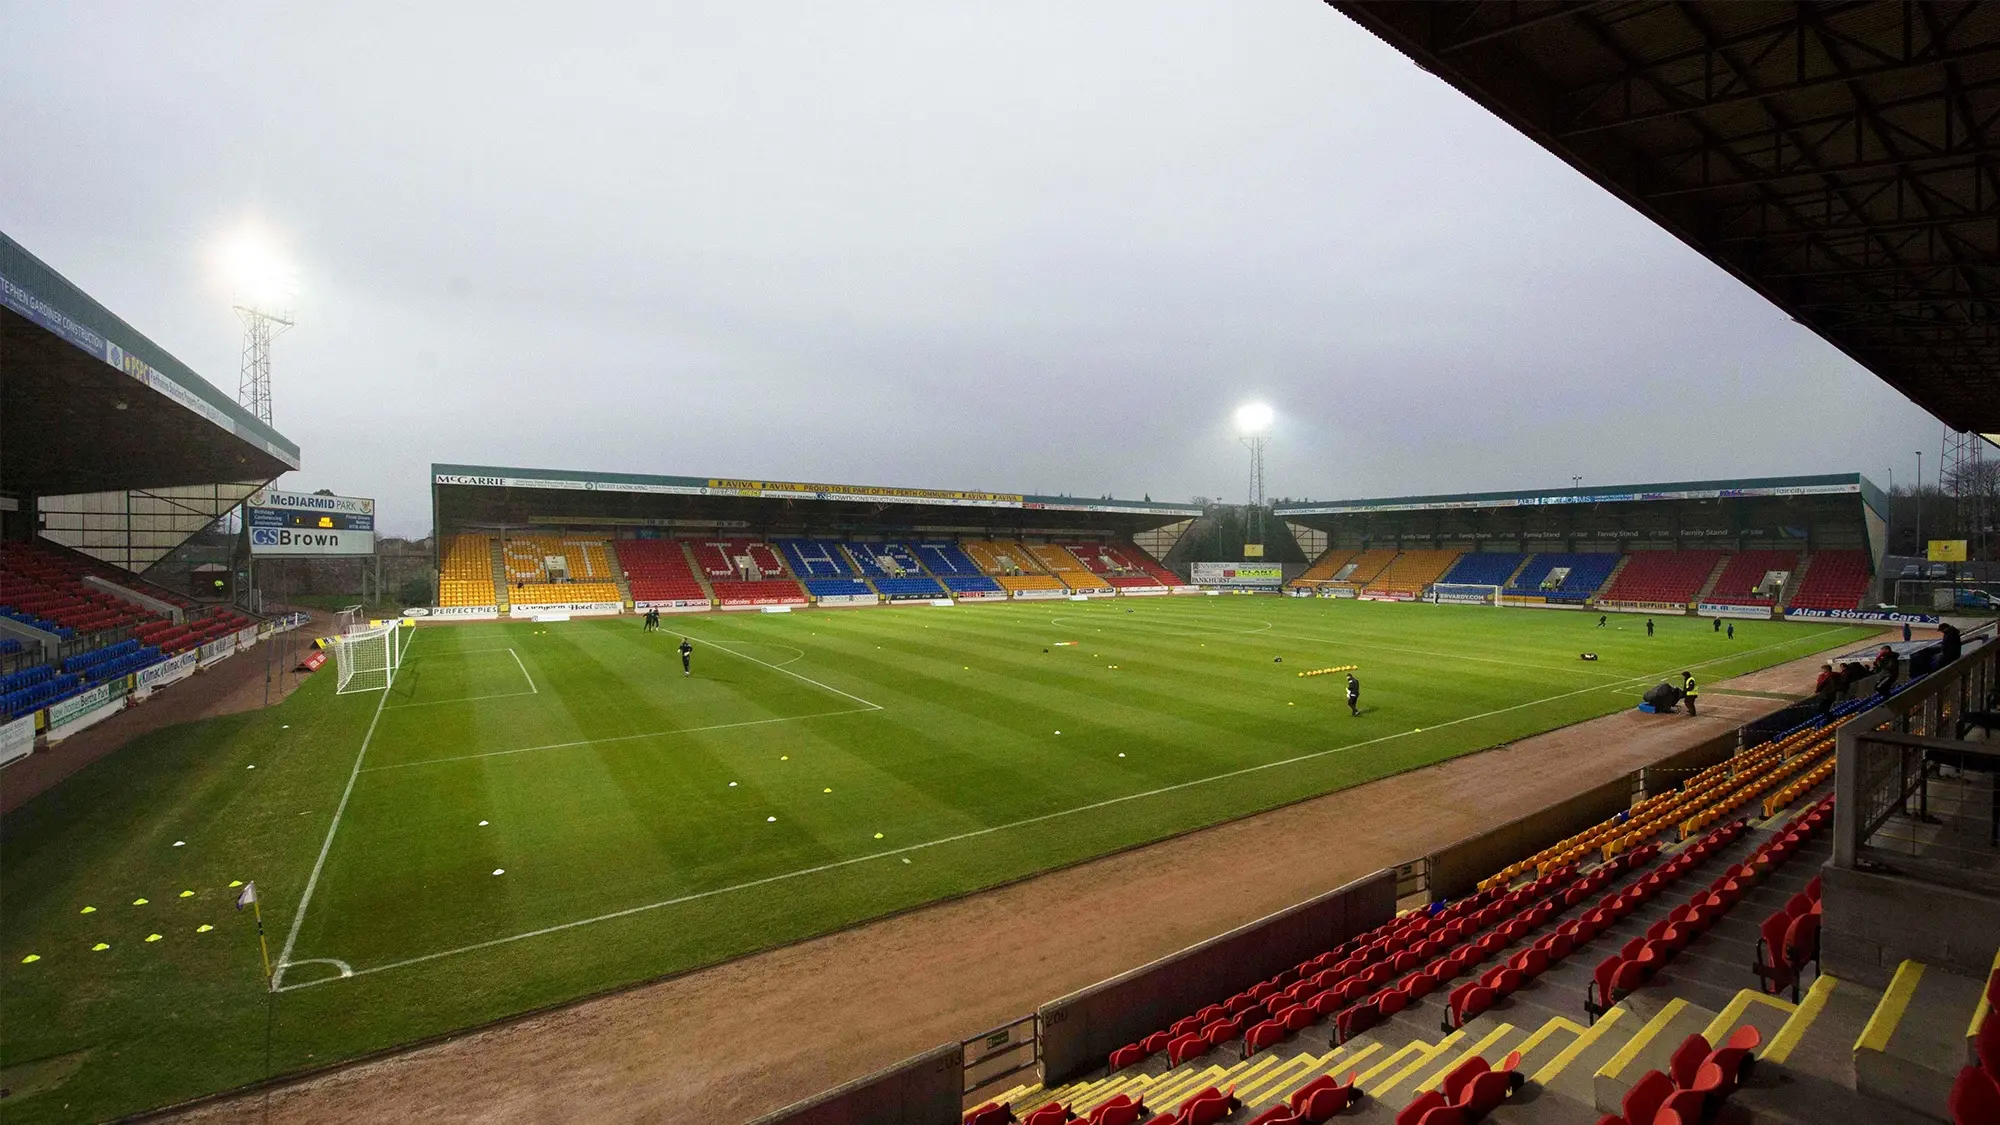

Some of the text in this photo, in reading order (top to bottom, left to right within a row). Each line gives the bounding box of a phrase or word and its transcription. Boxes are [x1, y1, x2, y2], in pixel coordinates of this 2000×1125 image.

[0, 277, 28, 305] TEPHEN
[62, 317, 104, 350] CONSTRUCTION
[726, 481, 754, 489] AVIVA
[770, 483, 796, 491] AVIVA
[804, 485, 830, 493] PROUD
[896, 489, 917, 497] PERTH
[918, 491, 956, 499] COMMUNITY
[967, 493, 988, 501] AVIVA
[998, 494, 1018, 502] AVIVA
[826, 493, 850, 501] Brown
[270, 495, 357, 511] McDIARMID PARK
[252, 528, 339, 546] GS Brown
[1681, 529, 1704, 537] Family
[433, 607, 475, 616] PERFECT
[477, 606, 497, 614] PIES
[569, 603, 593, 611] Hotel
[1792, 607, 1921, 623] Alan Storrar Cars
